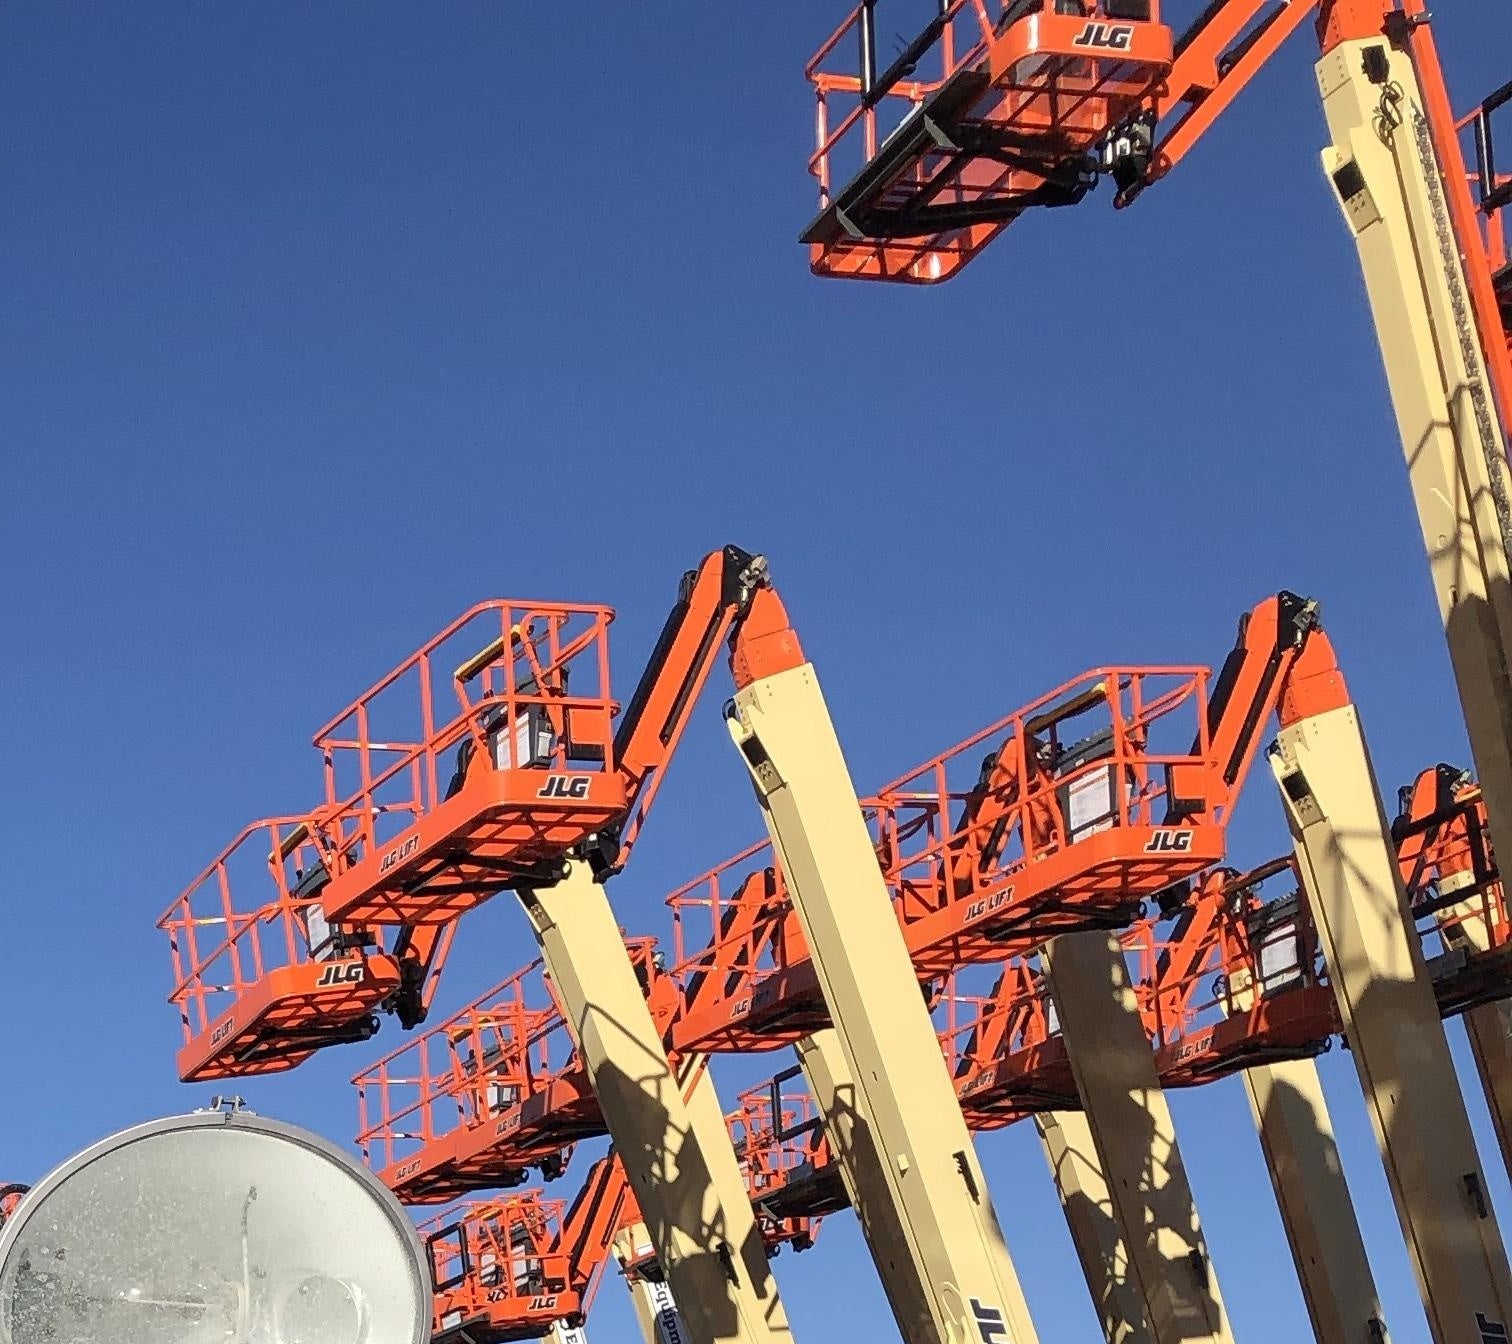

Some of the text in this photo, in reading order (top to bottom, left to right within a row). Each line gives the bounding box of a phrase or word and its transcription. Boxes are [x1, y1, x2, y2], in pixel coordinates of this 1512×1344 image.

[1073, 23, 1133, 50] JLG
[538, 776, 590, 798] JLG
[1145, 831, 1192, 852] JLG
[380, 834, 420, 874] JLG LIFT
[965, 886, 1014, 921] JLG LIFT
[317, 963, 364, 987] JLG
[731, 999, 749, 1018] JLG
[222, 1018, 234, 1039] LIFT
[1175, 1045, 1192, 1059] JLG
[529, 1297, 557, 1311] JLG
